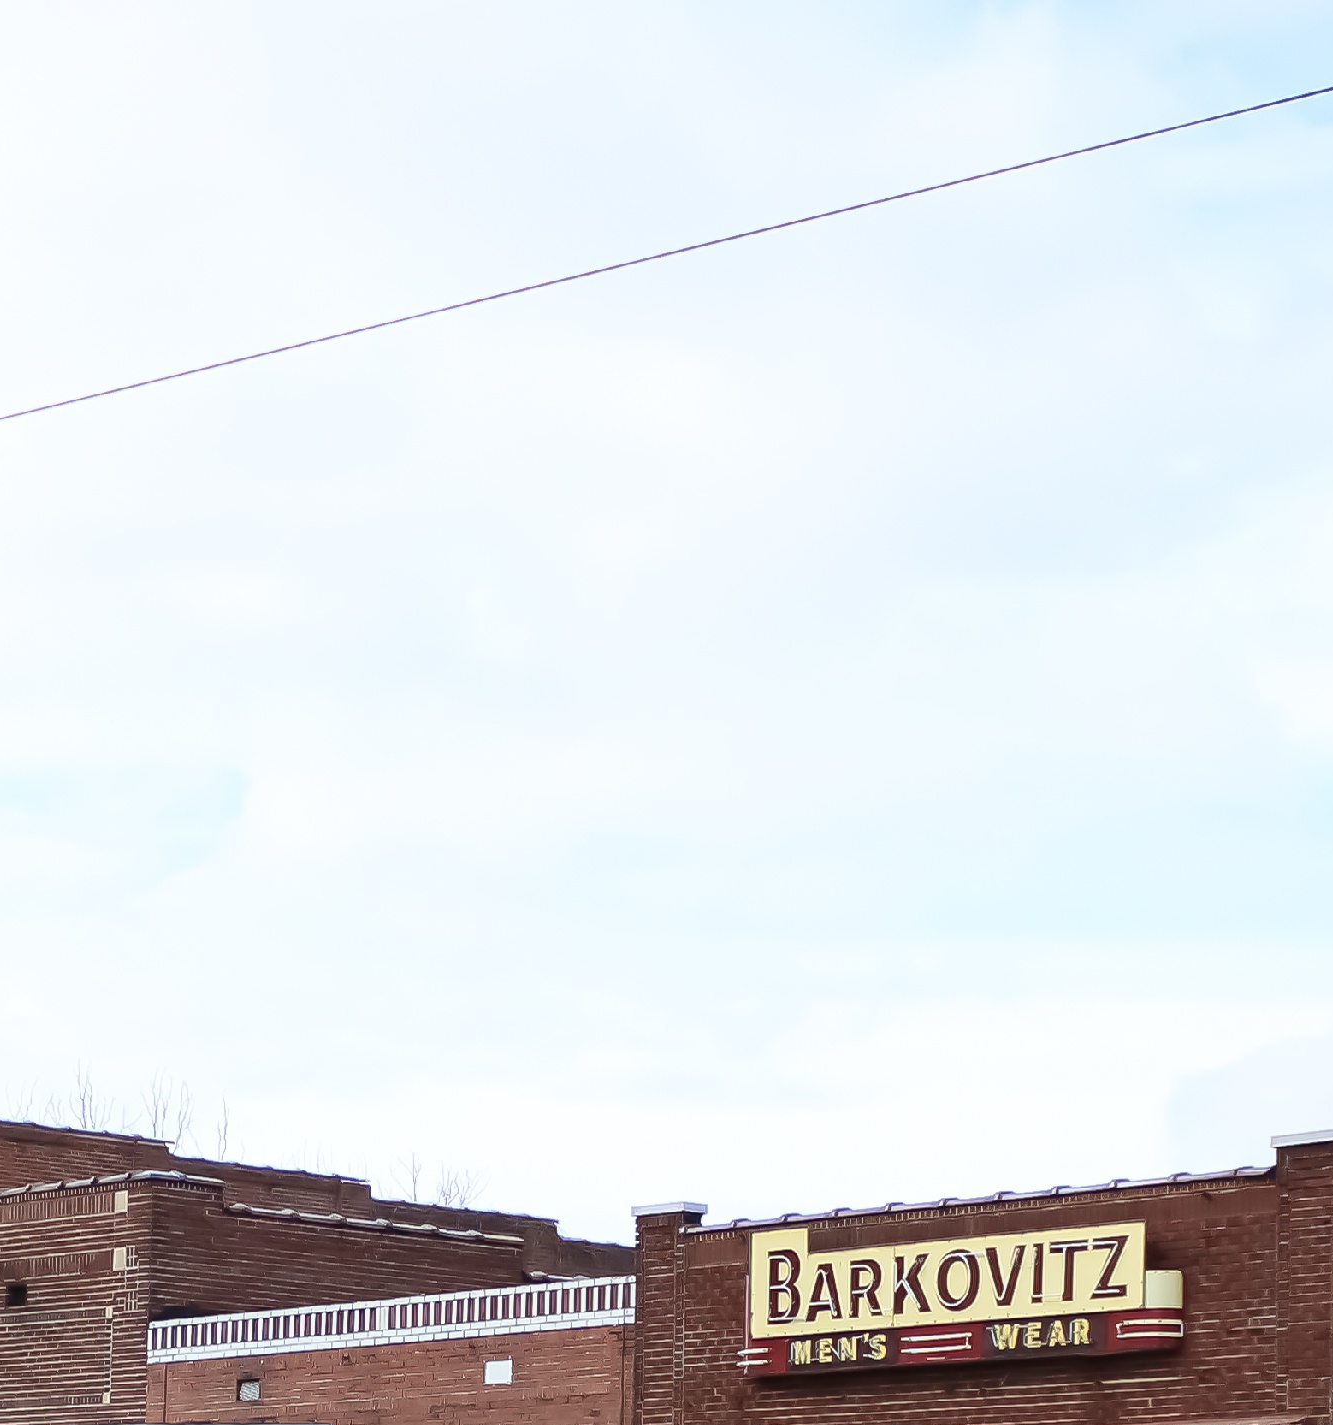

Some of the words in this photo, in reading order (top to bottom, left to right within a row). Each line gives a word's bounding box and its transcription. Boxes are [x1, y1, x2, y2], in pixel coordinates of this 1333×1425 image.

[767, 1235, 1130, 1325] BARKOVITZ
[789, 1332, 888, 1366] MEN'S
[986, 1318, 1093, 1351] WEAR
